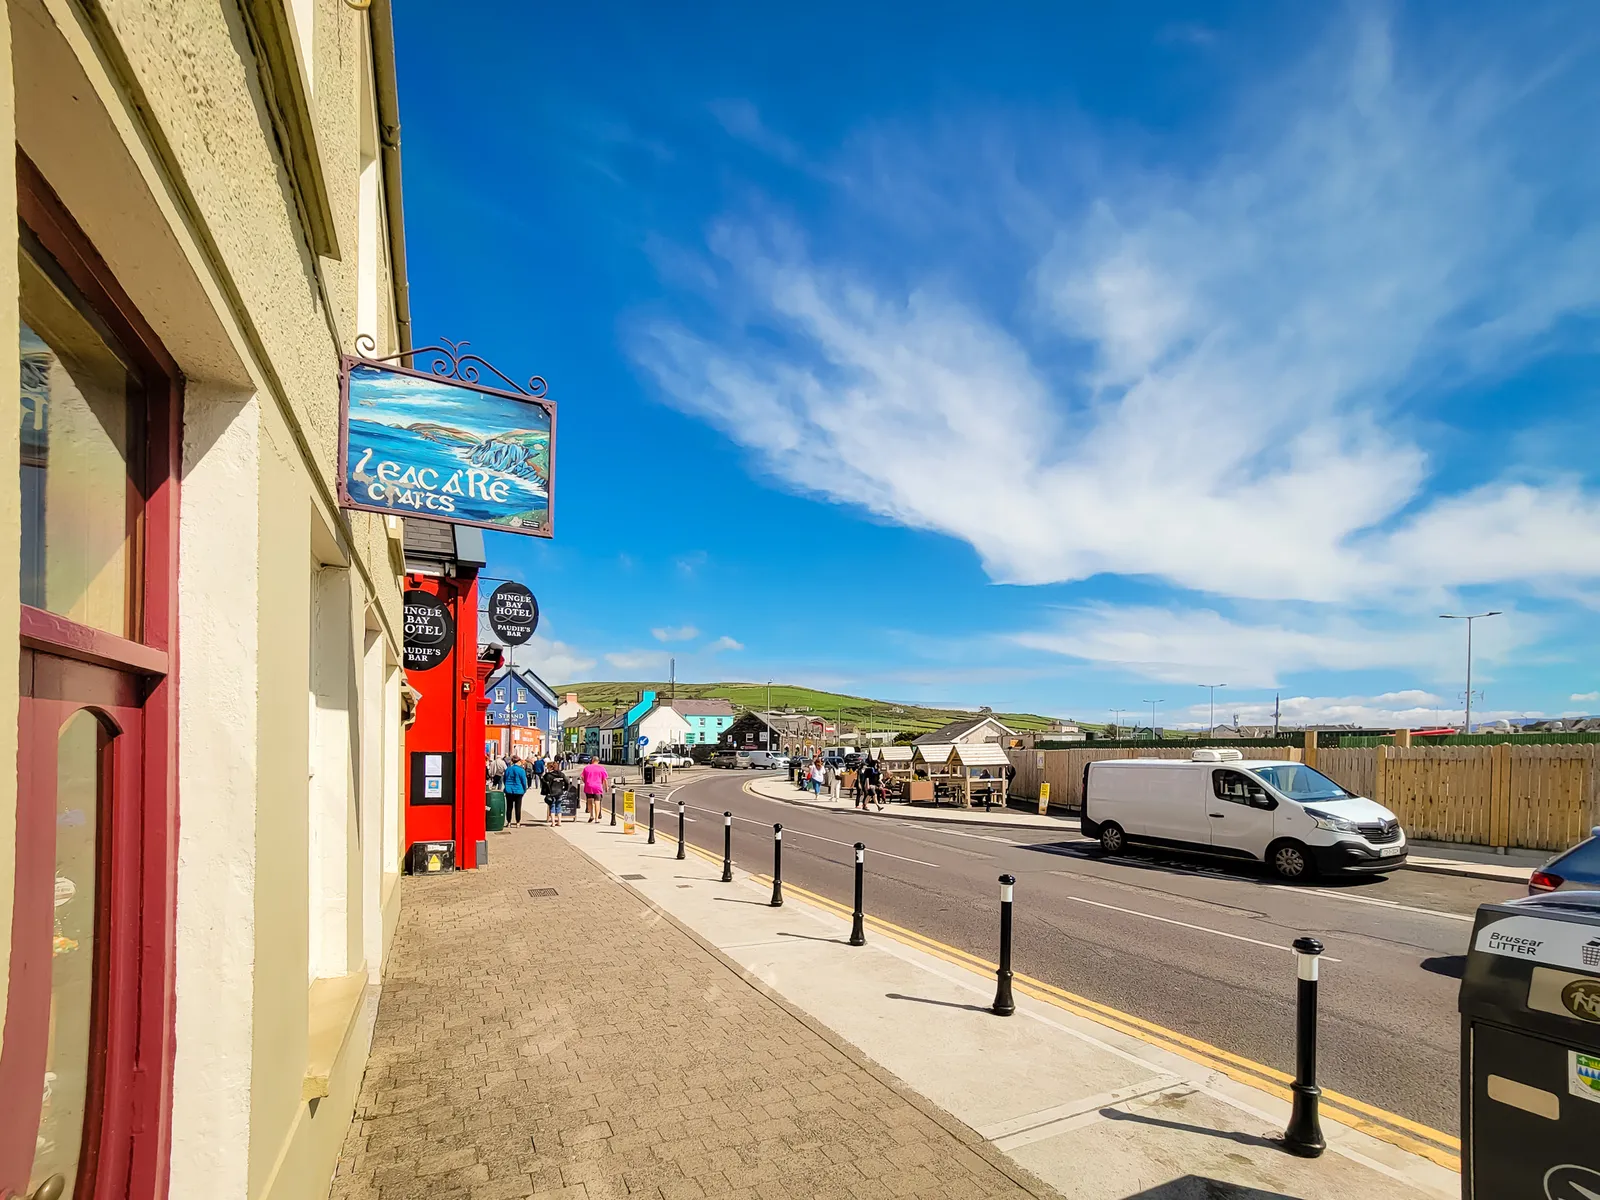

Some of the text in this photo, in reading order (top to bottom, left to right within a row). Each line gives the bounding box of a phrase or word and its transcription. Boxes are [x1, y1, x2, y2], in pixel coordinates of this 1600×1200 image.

[496, 593, 532, 603] DINGLE
[506, 601, 523, 609] BAY
[404, 606, 442, 618] INGLE
[496, 607, 532, 617] HOTEL
[407, 615, 430, 624] BAY
[404, 624, 443, 636] OTEL
[497, 625, 531, 633] PAUDIE'S
[403, 647, 441, 656] AUDIE'S
[408, 654, 428, 662] BAR
[1490, 932, 1544, 947] Bruscar
[1488, 940, 1537, 956] LITTER
